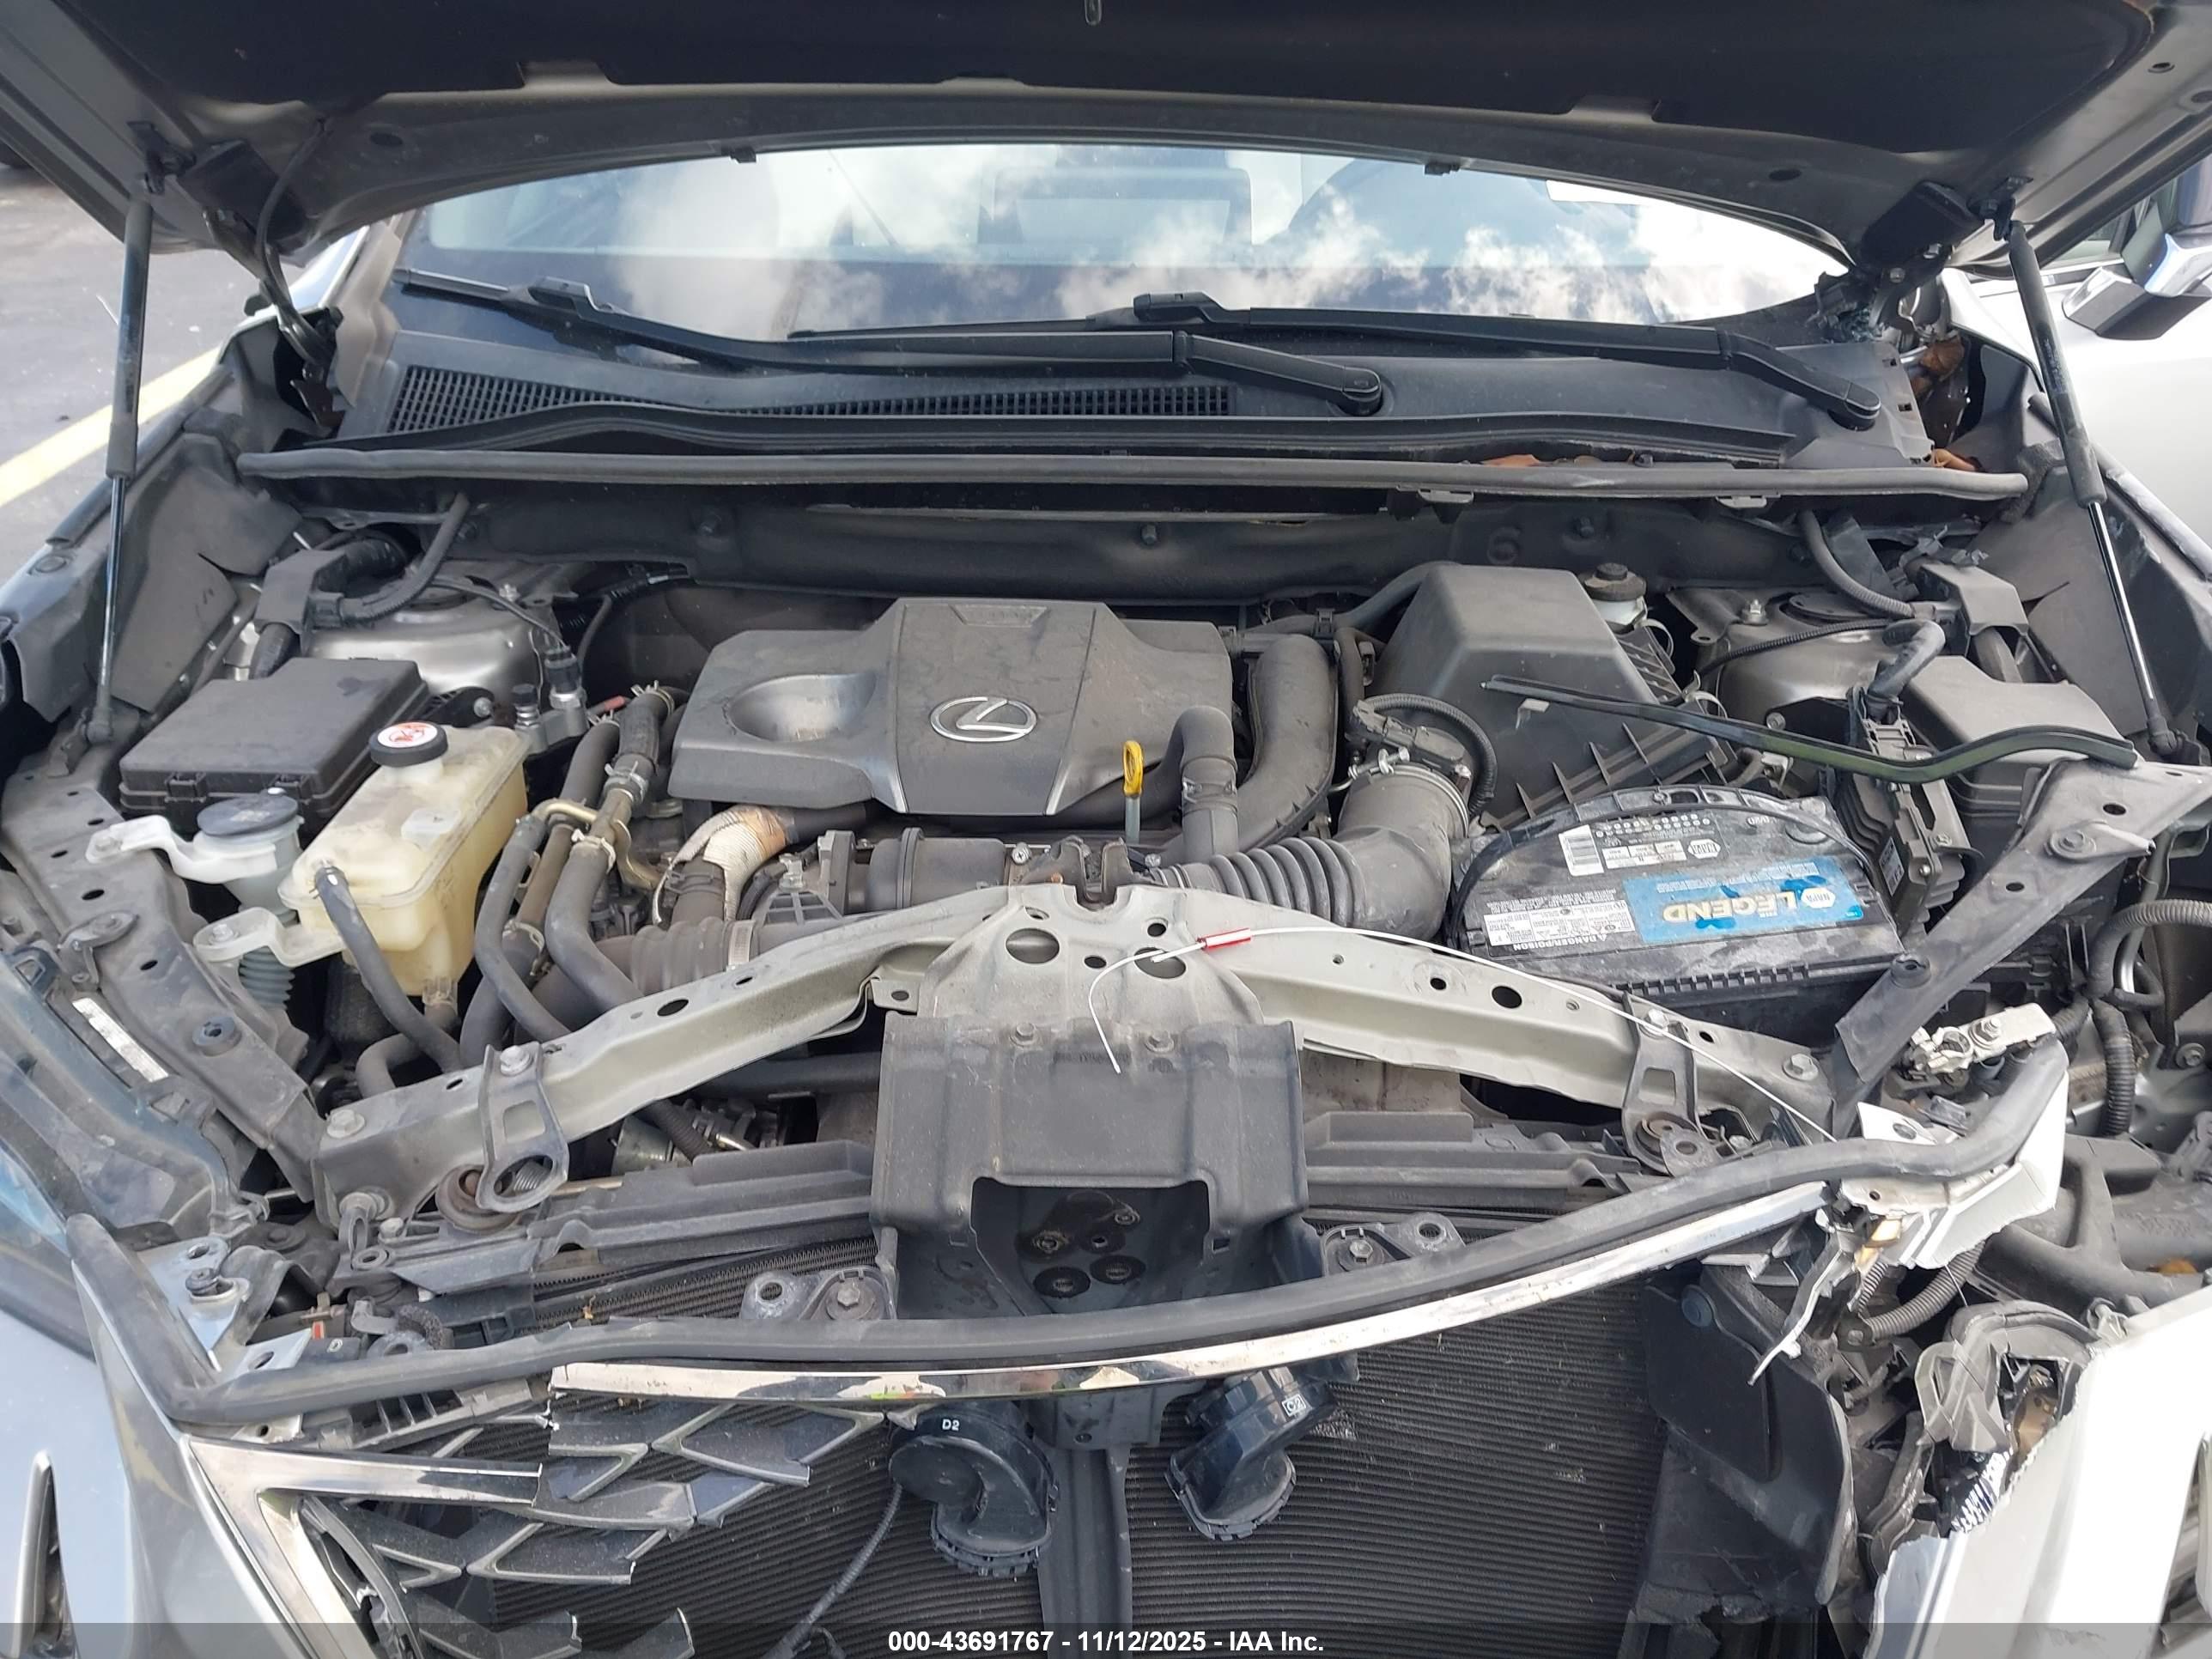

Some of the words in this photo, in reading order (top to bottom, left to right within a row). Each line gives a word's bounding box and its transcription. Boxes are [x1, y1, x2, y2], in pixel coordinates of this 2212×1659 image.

[1805, 891, 1831, 904] NAPA
[1662, 892, 1797, 921] LEGEND
[1286, 1396, 1305, 1413] C2
[941, 1418, 960, 1431] D2
